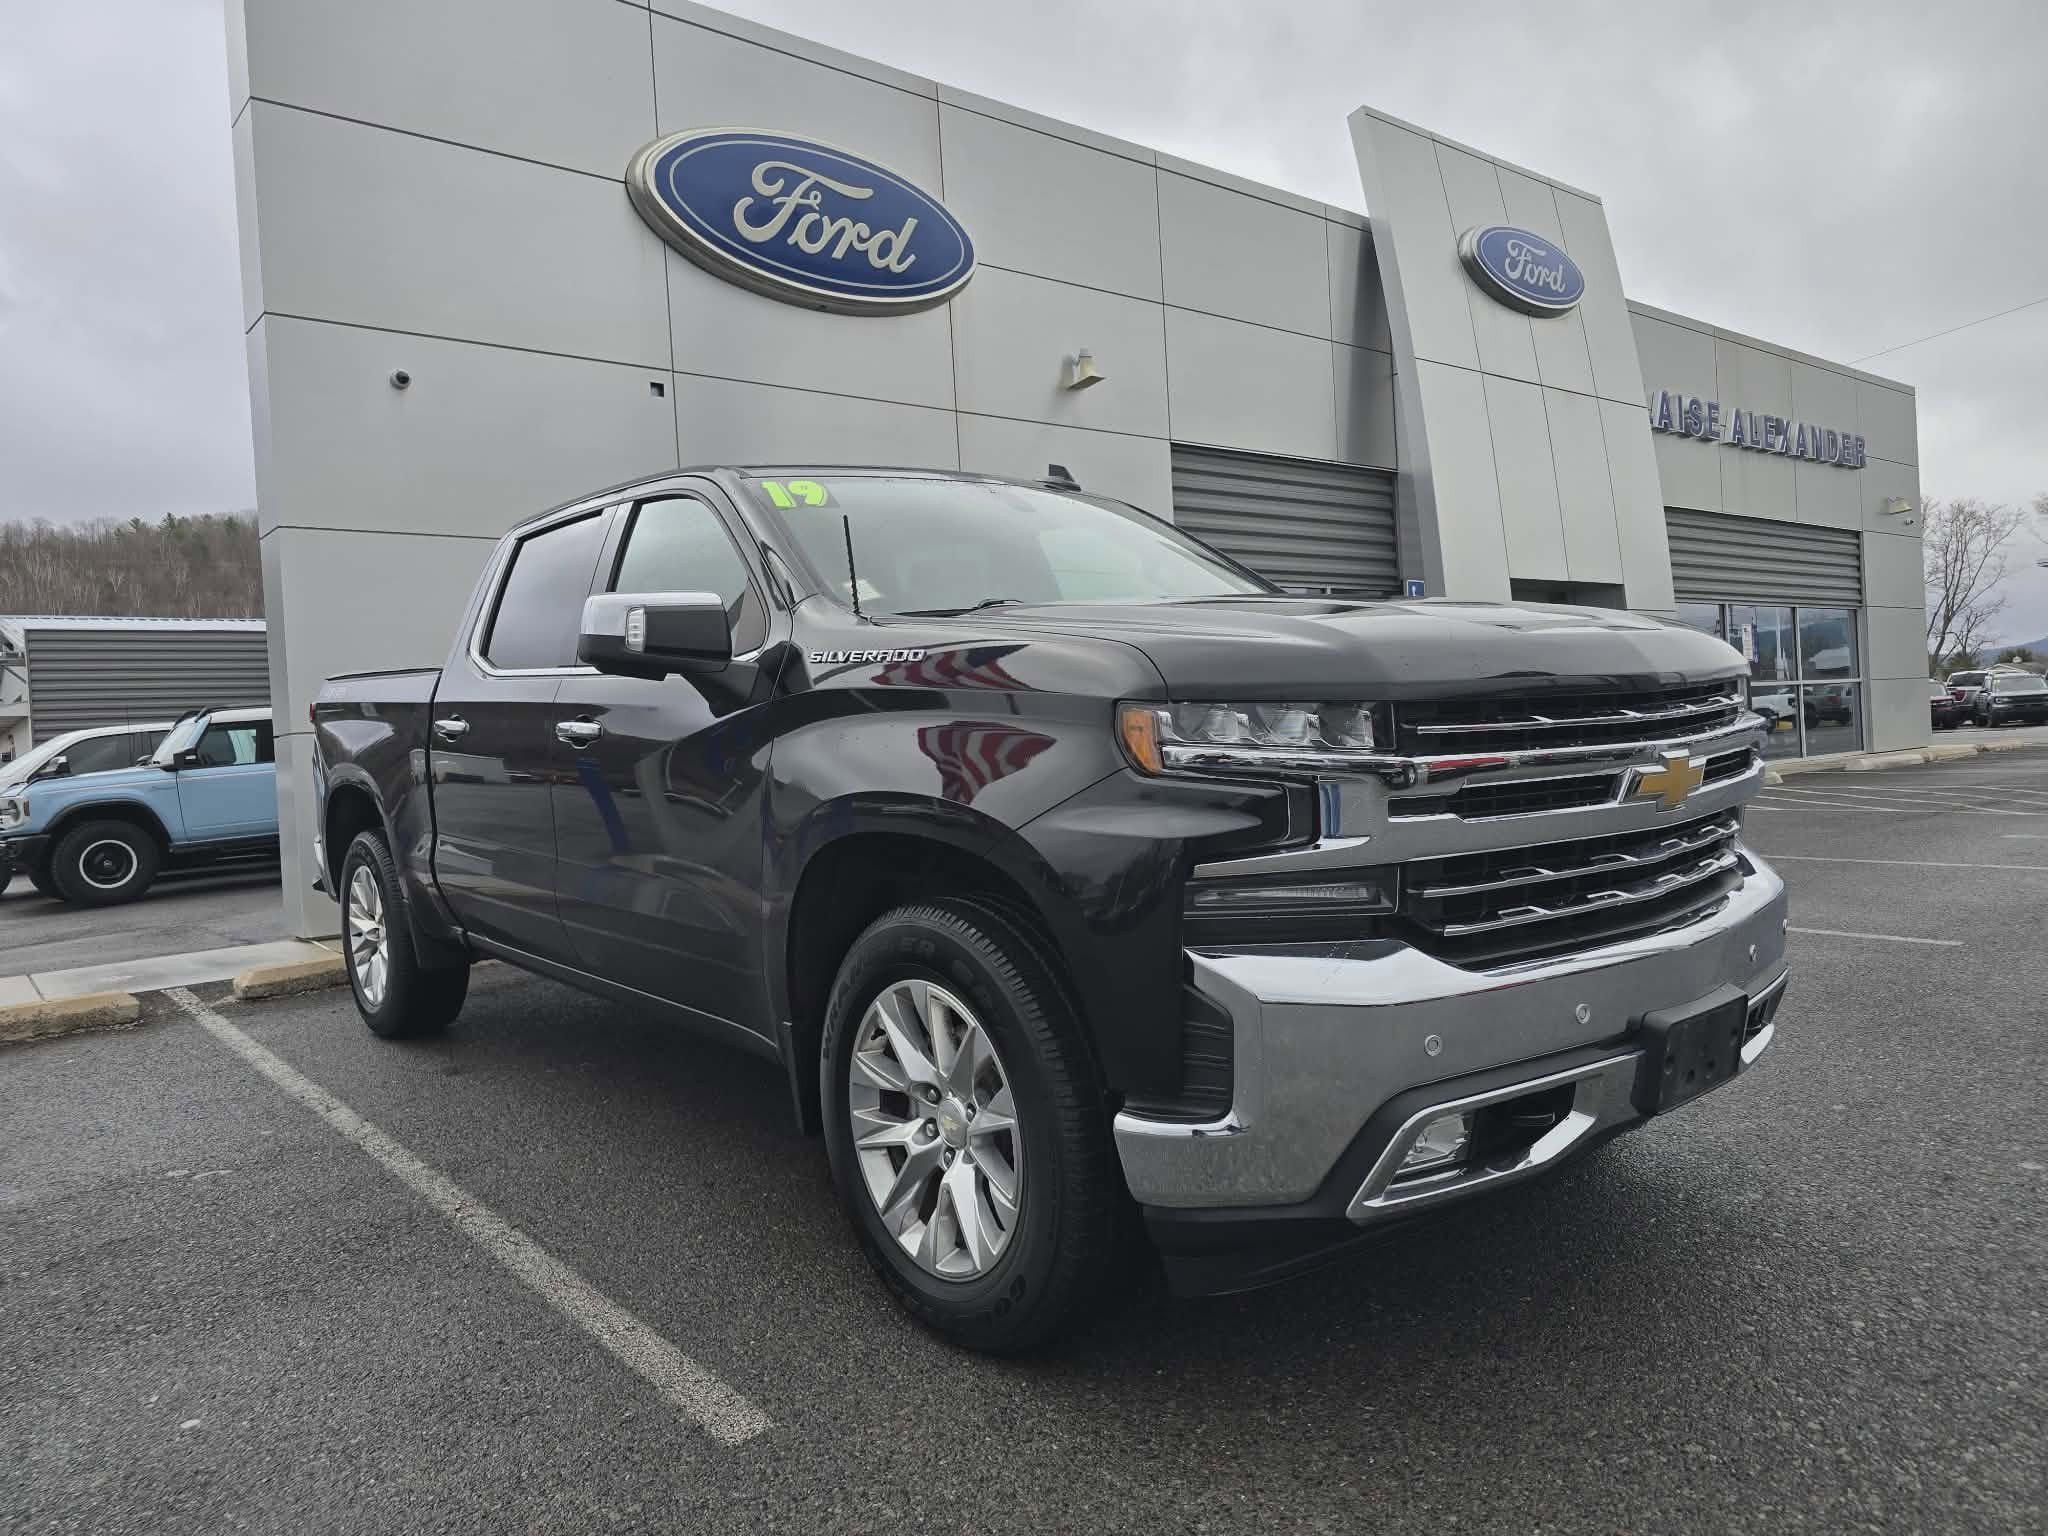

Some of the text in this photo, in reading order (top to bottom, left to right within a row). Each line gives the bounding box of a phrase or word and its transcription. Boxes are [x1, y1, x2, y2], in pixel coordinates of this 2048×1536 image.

[735, 161, 918, 273] Ford
[1505, 240, 1566, 293] Ford
[1650, 390, 1866, 467] AISE ALEXANDER
[761, 480, 828, 508] 19
[810, 649, 926, 664] SILVERADO
